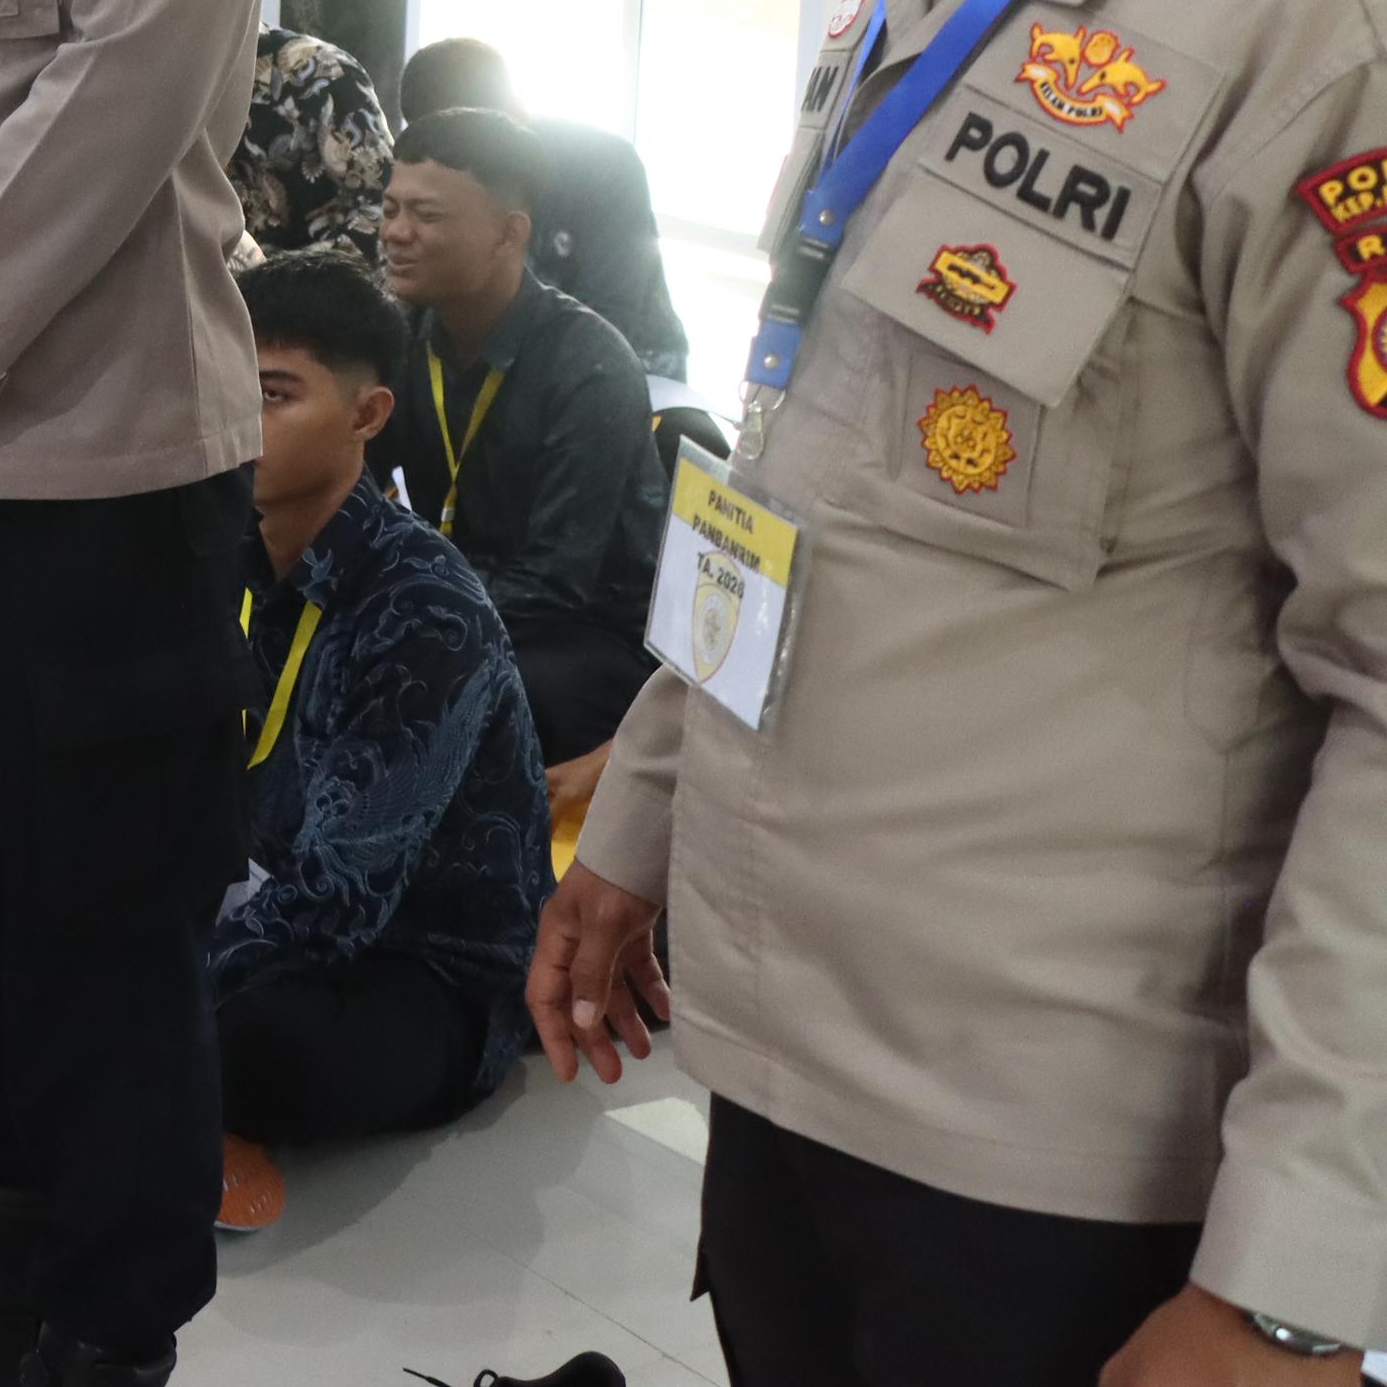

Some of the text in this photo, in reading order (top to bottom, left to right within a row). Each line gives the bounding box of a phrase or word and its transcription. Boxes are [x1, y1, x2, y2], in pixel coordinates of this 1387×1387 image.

[944, 111, 1132, 242] POLRI
[707, 489, 754, 534] PANITIA
[697, 552, 714, 578] TA.
